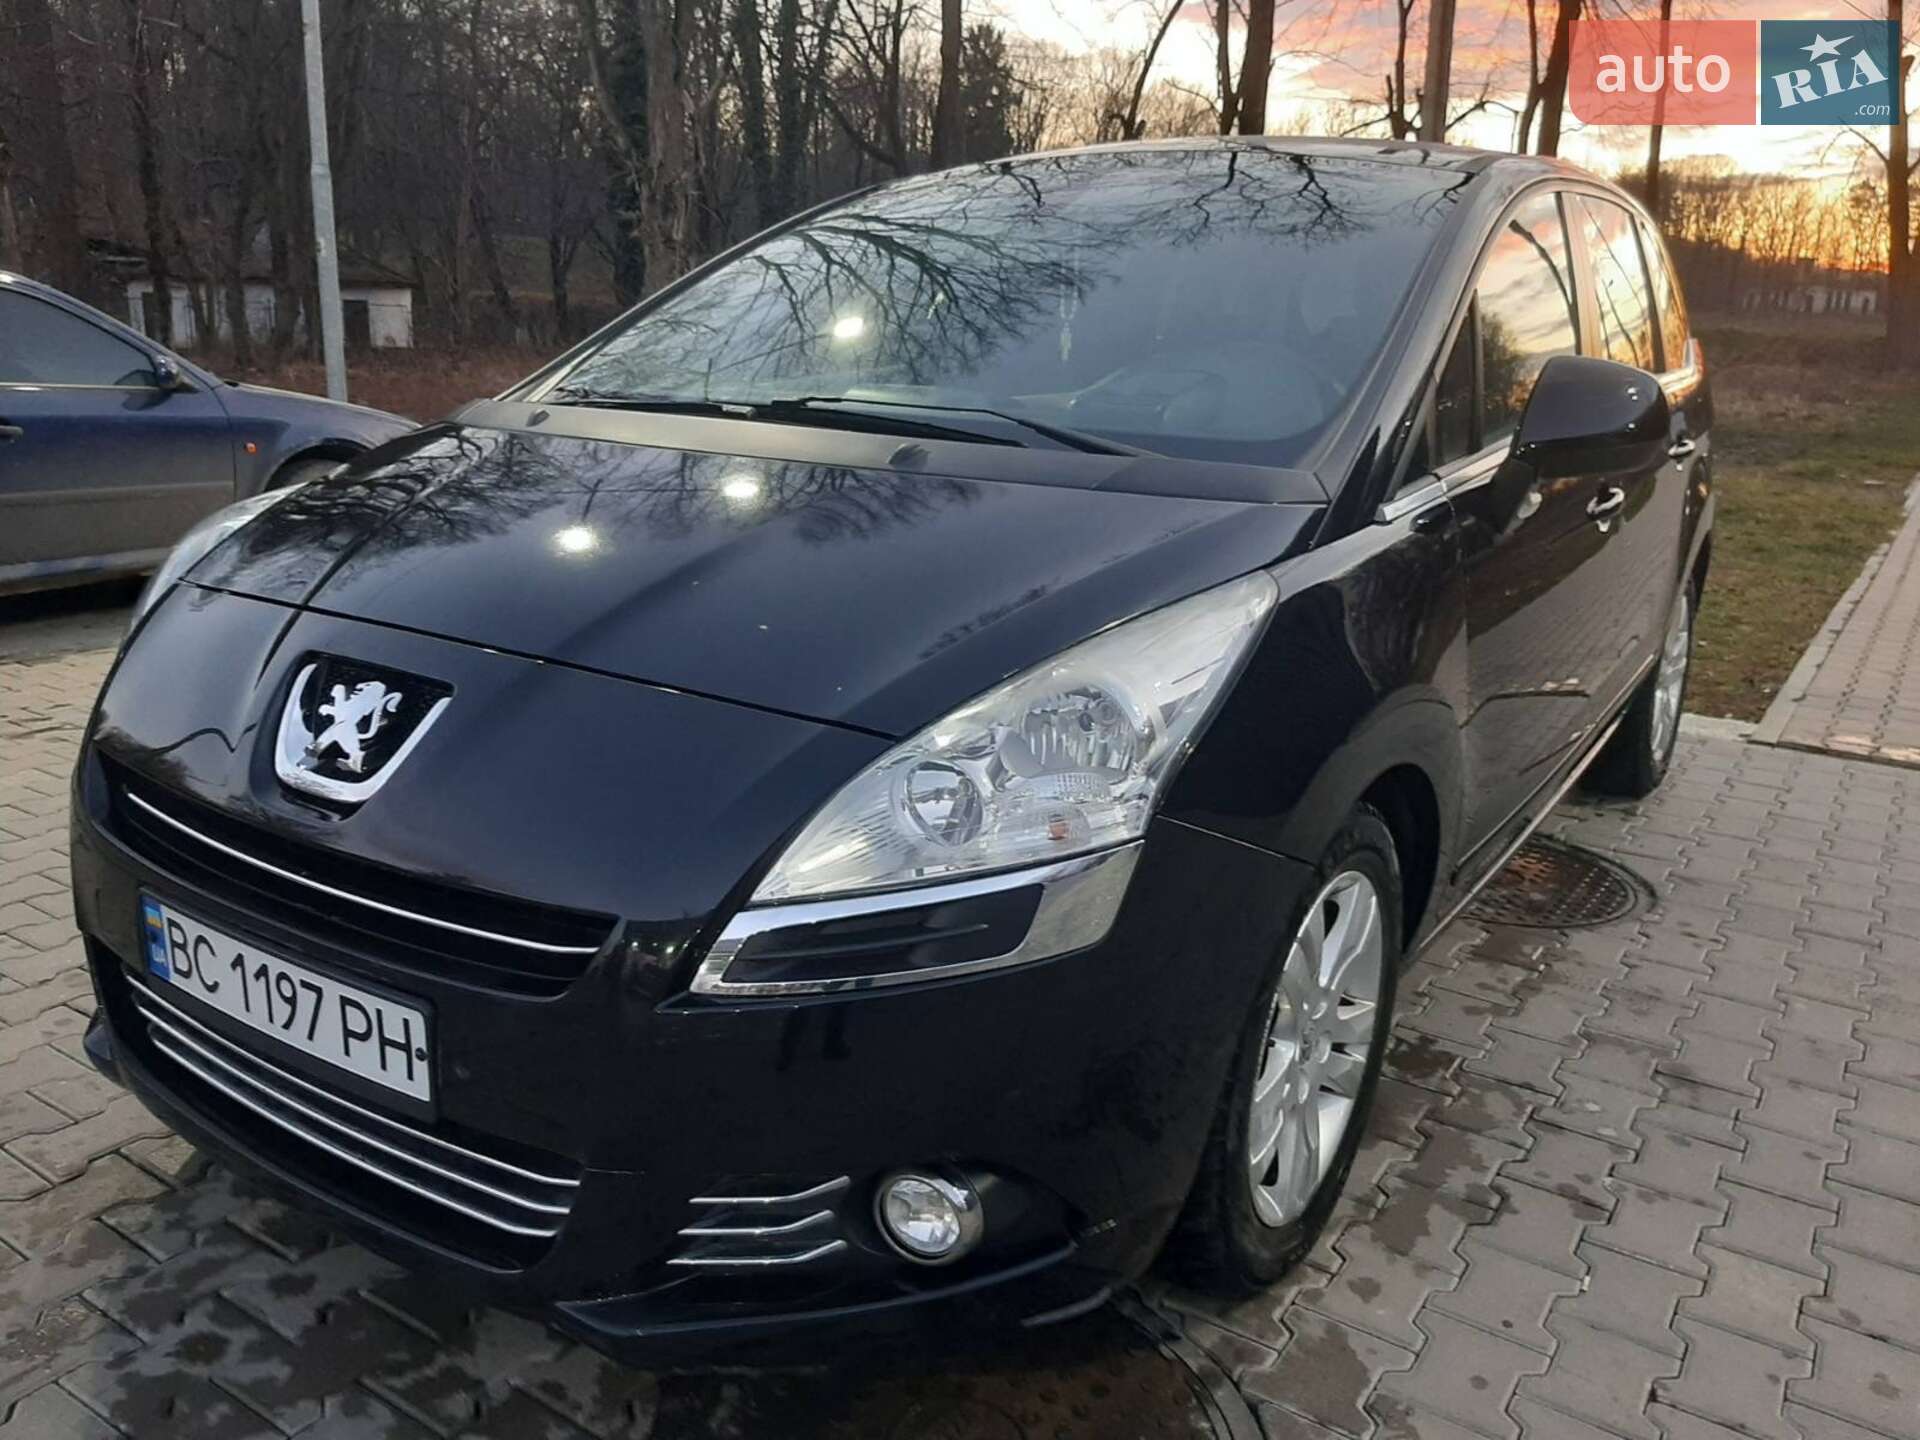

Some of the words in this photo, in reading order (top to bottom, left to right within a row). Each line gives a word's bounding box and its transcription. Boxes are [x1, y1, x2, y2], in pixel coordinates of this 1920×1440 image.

[166, 916, 220, 993] BC
[230, 952, 324, 1041] 1197
[338, 994, 415, 1082] PH
